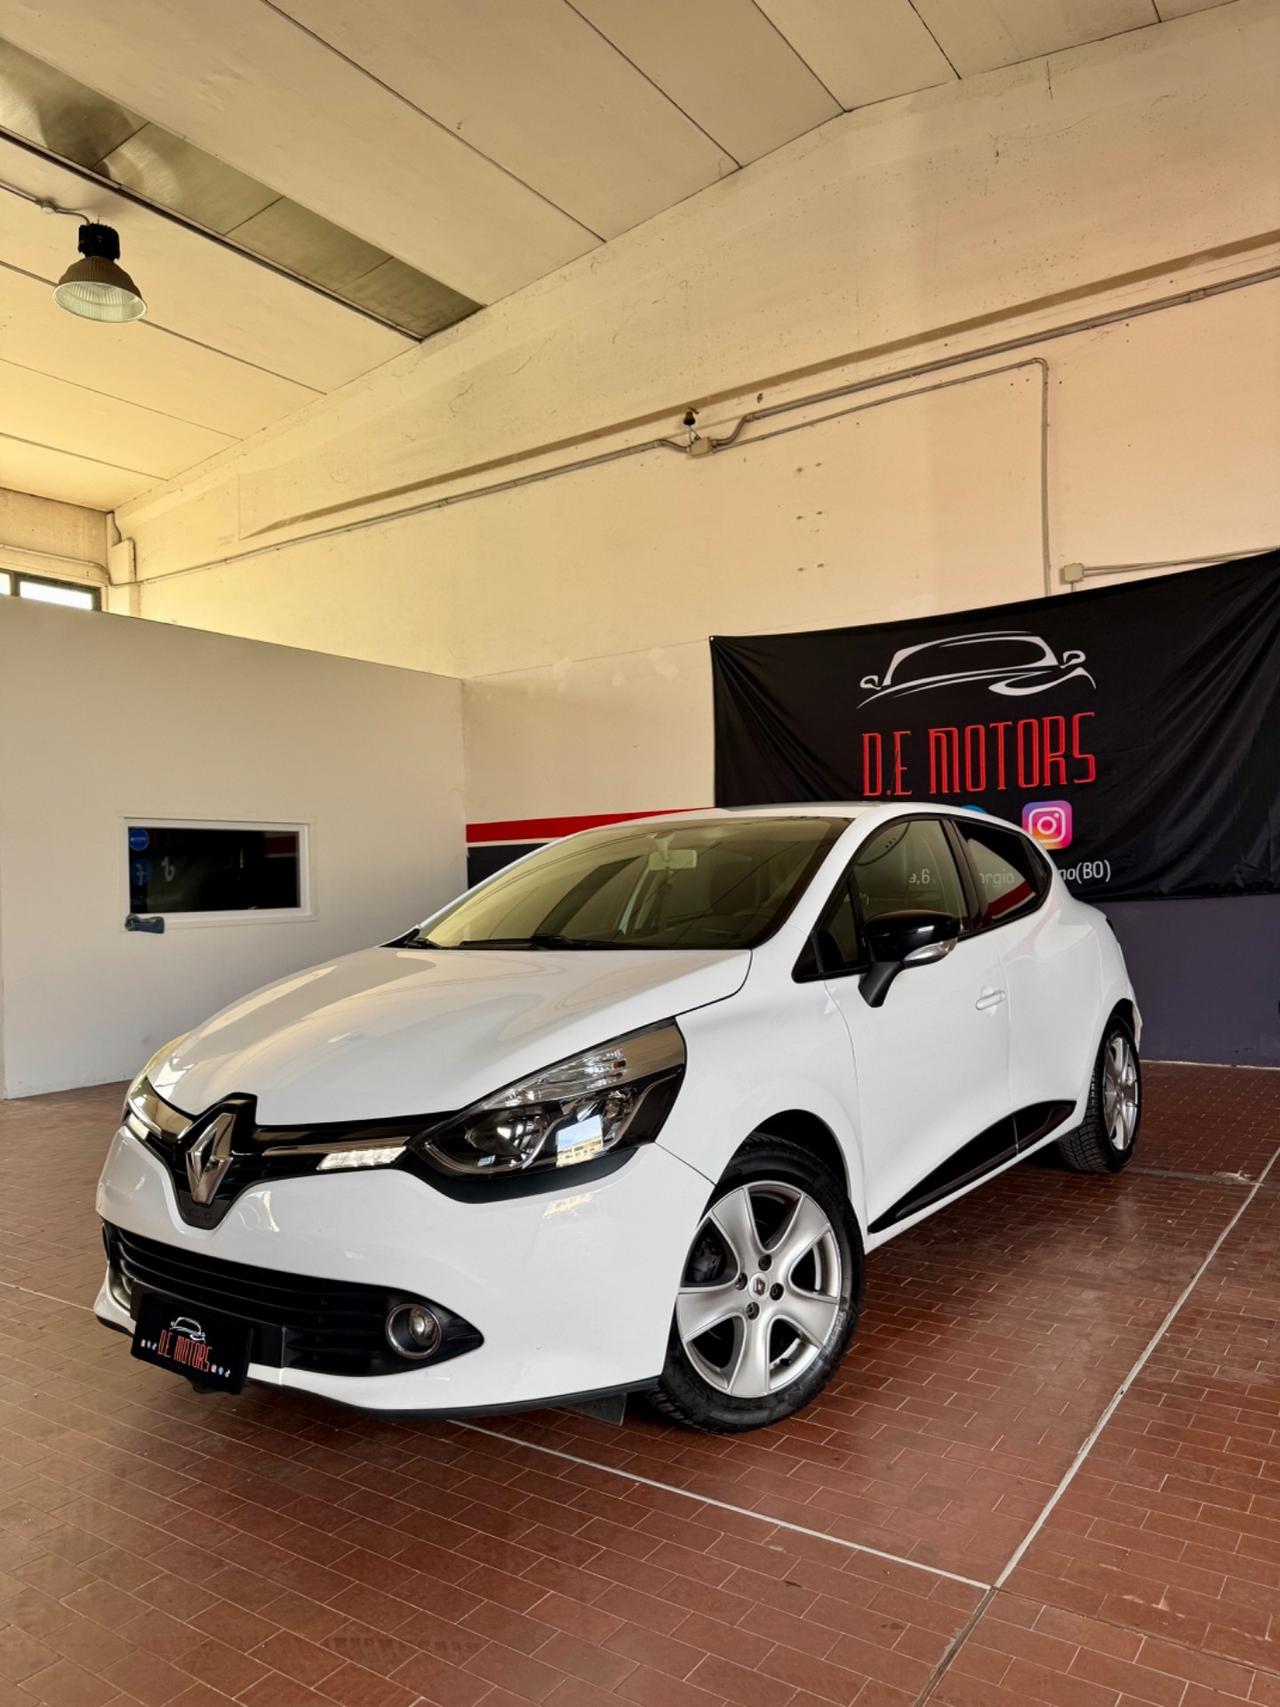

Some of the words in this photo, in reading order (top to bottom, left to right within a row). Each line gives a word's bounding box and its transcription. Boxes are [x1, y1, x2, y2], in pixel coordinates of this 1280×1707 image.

[862, 731, 912, 796] D.E
[928, 712, 1097, 794] MOTORS
[173, 1335, 213, 1372] MOTORS
